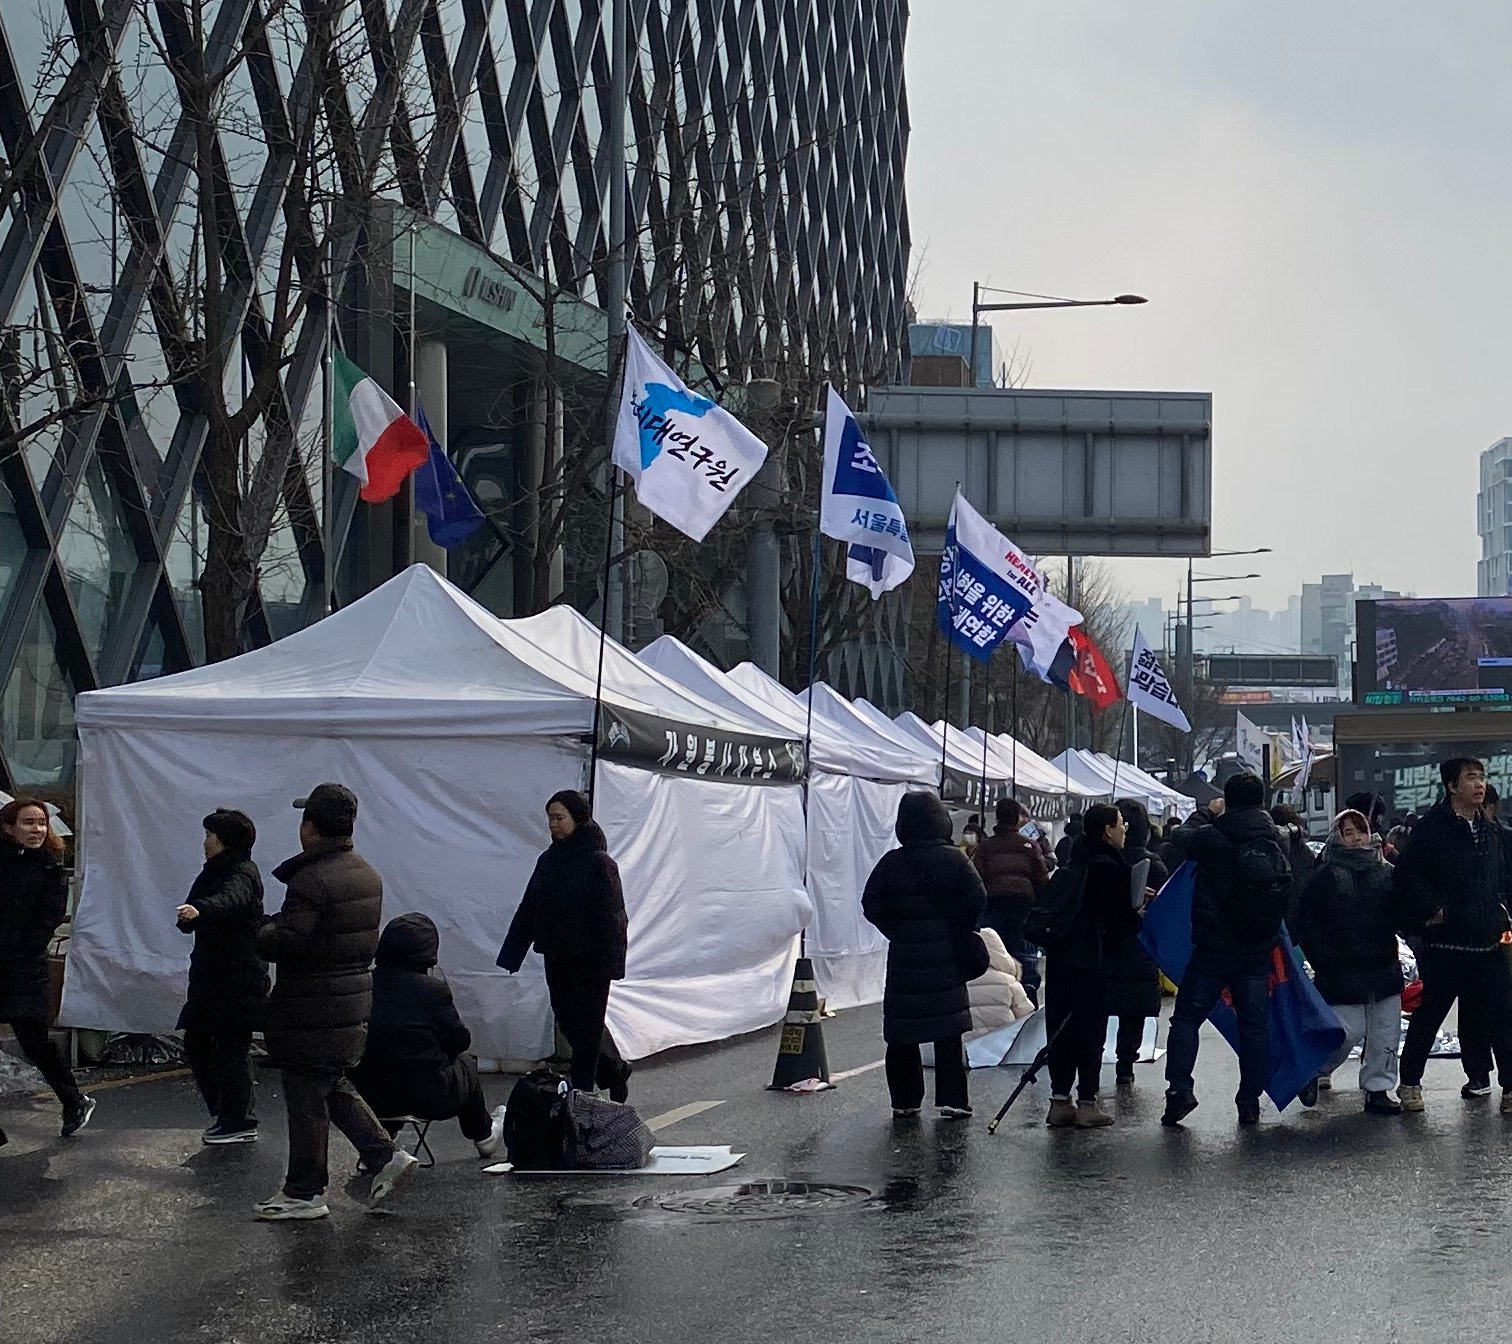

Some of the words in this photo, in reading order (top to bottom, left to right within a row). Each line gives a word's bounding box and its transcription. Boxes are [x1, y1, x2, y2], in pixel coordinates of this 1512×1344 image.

[957, 568, 986, 606] 현을
[980, 594, 1015, 628] 위한
[1016, 576, 1037, 596] ALL
